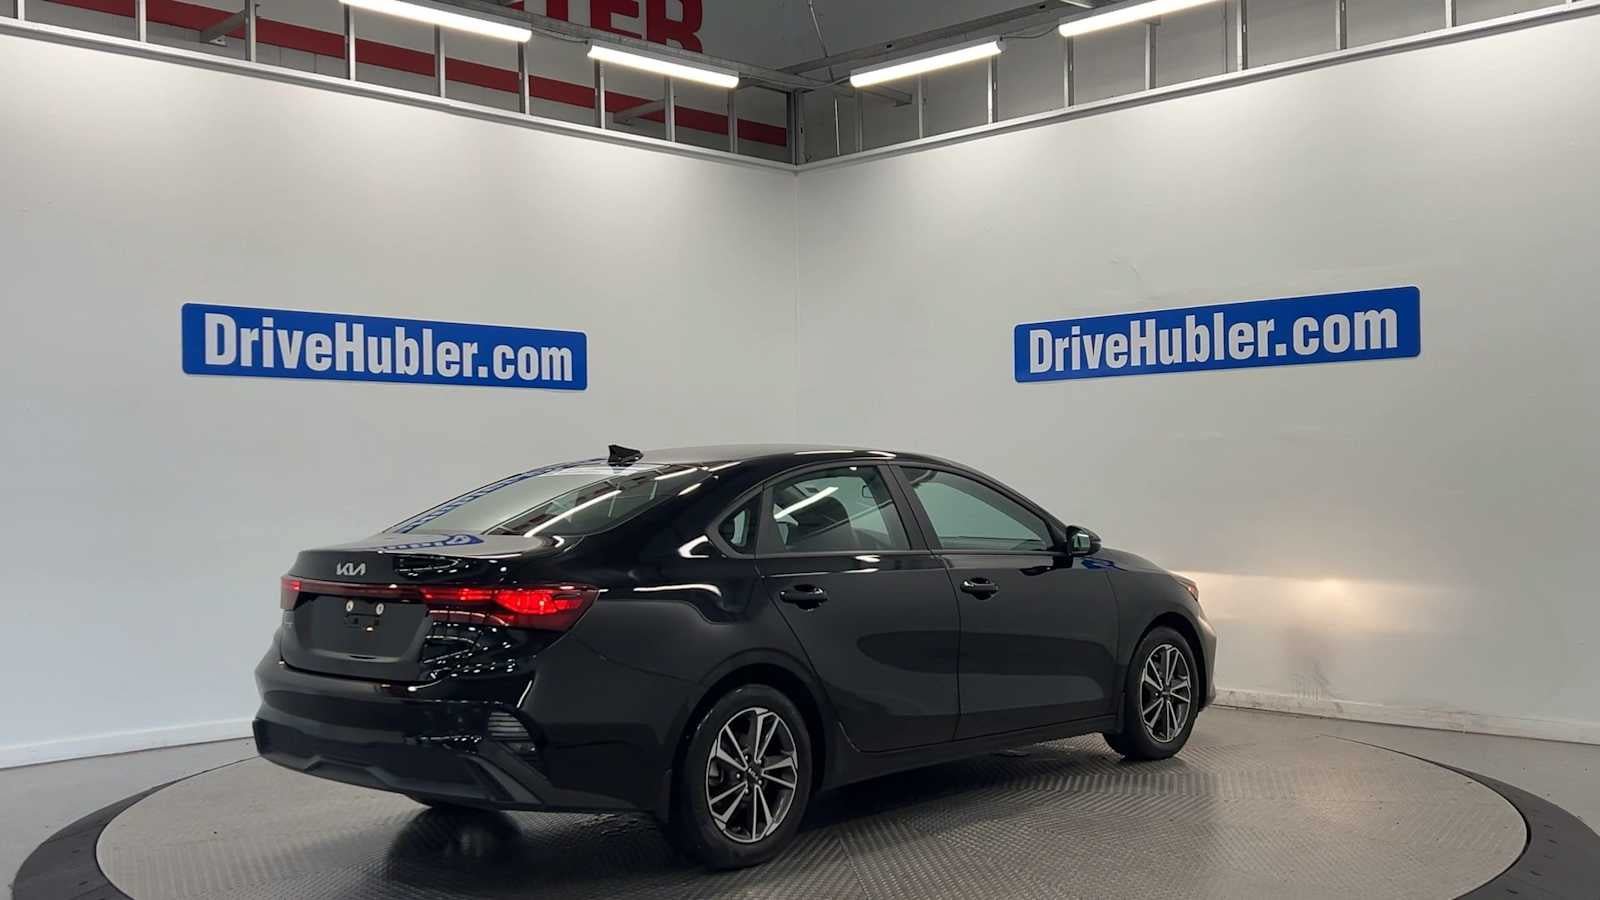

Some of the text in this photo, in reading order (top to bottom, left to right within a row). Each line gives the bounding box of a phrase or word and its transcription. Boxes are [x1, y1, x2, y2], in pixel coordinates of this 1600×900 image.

[204, 312, 573, 382] DriveHubler.com
[1029, 307, 1398, 374] DriveHubler.com
[336, 562, 366, 576] KIA
